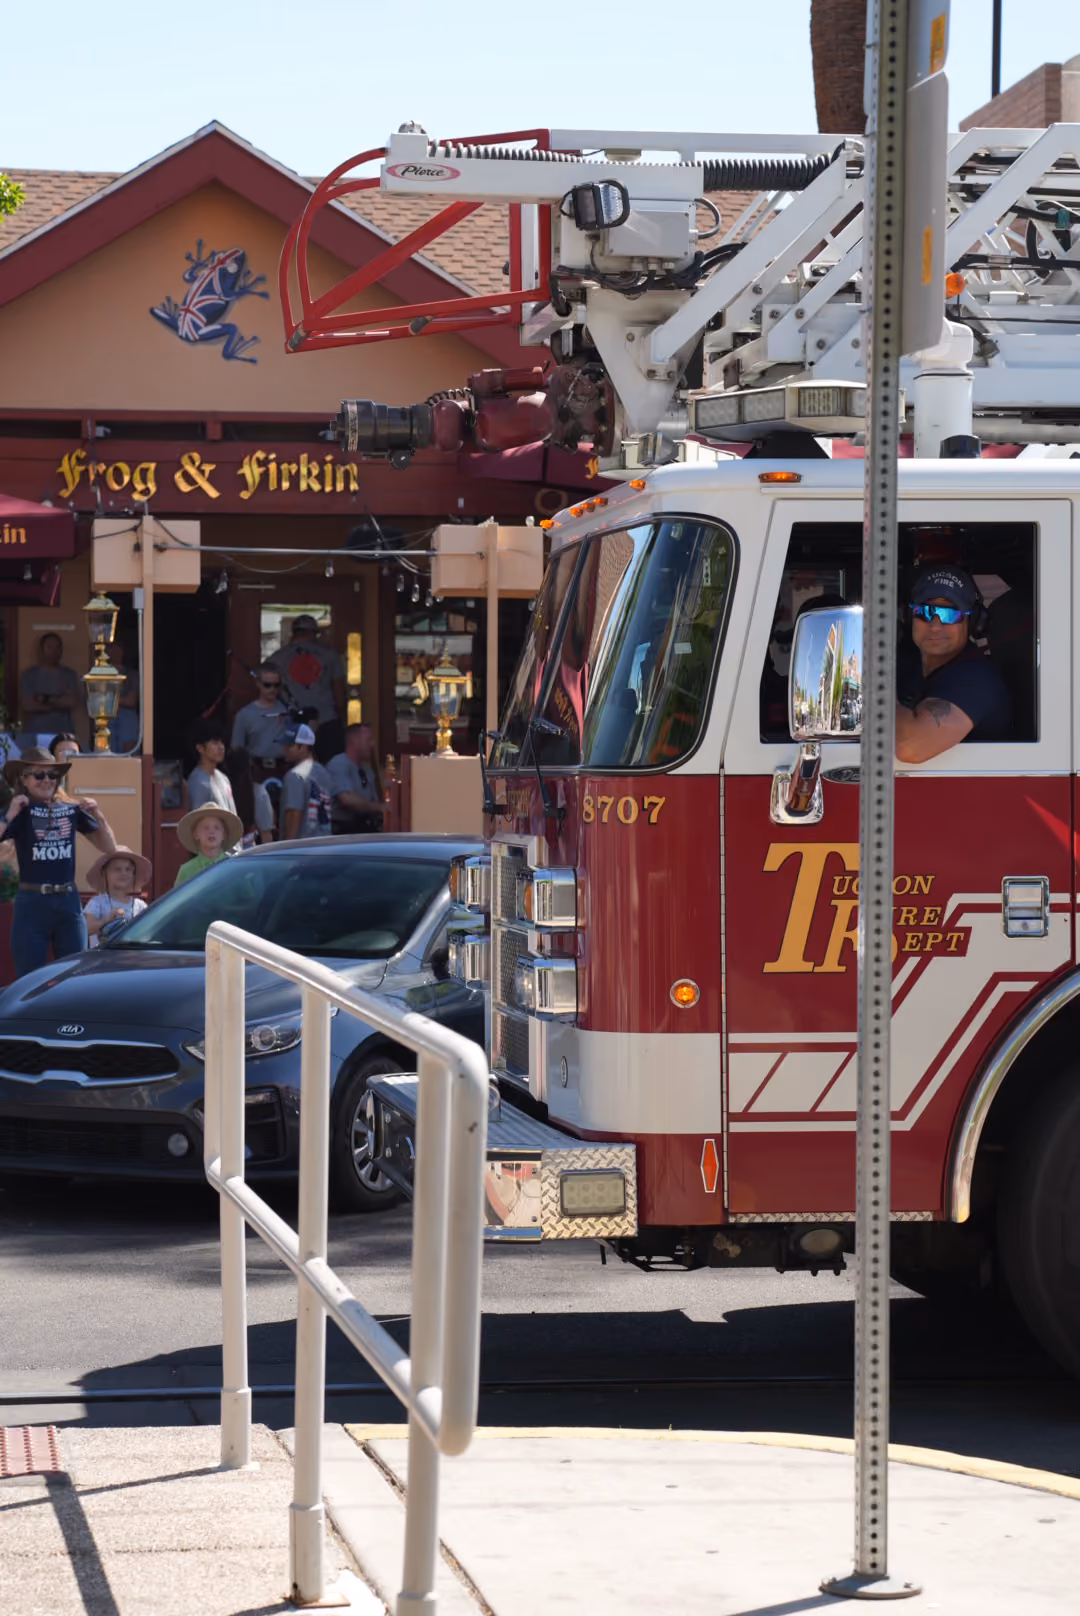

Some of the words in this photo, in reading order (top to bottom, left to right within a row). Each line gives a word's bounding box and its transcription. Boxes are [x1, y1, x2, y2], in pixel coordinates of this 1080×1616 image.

[401, 165, 446, 177] Pierce
[56, 448, 158, 501] Frog
[174, 451, 221, 499] &
[237, 449, 360, 500] Firkin
[0, 523, 26, 544] in
[582, 795, 666, 825] 8707
[32, 844, 72, 861] MOM
[60, 1024, 79, 1033] KIA
